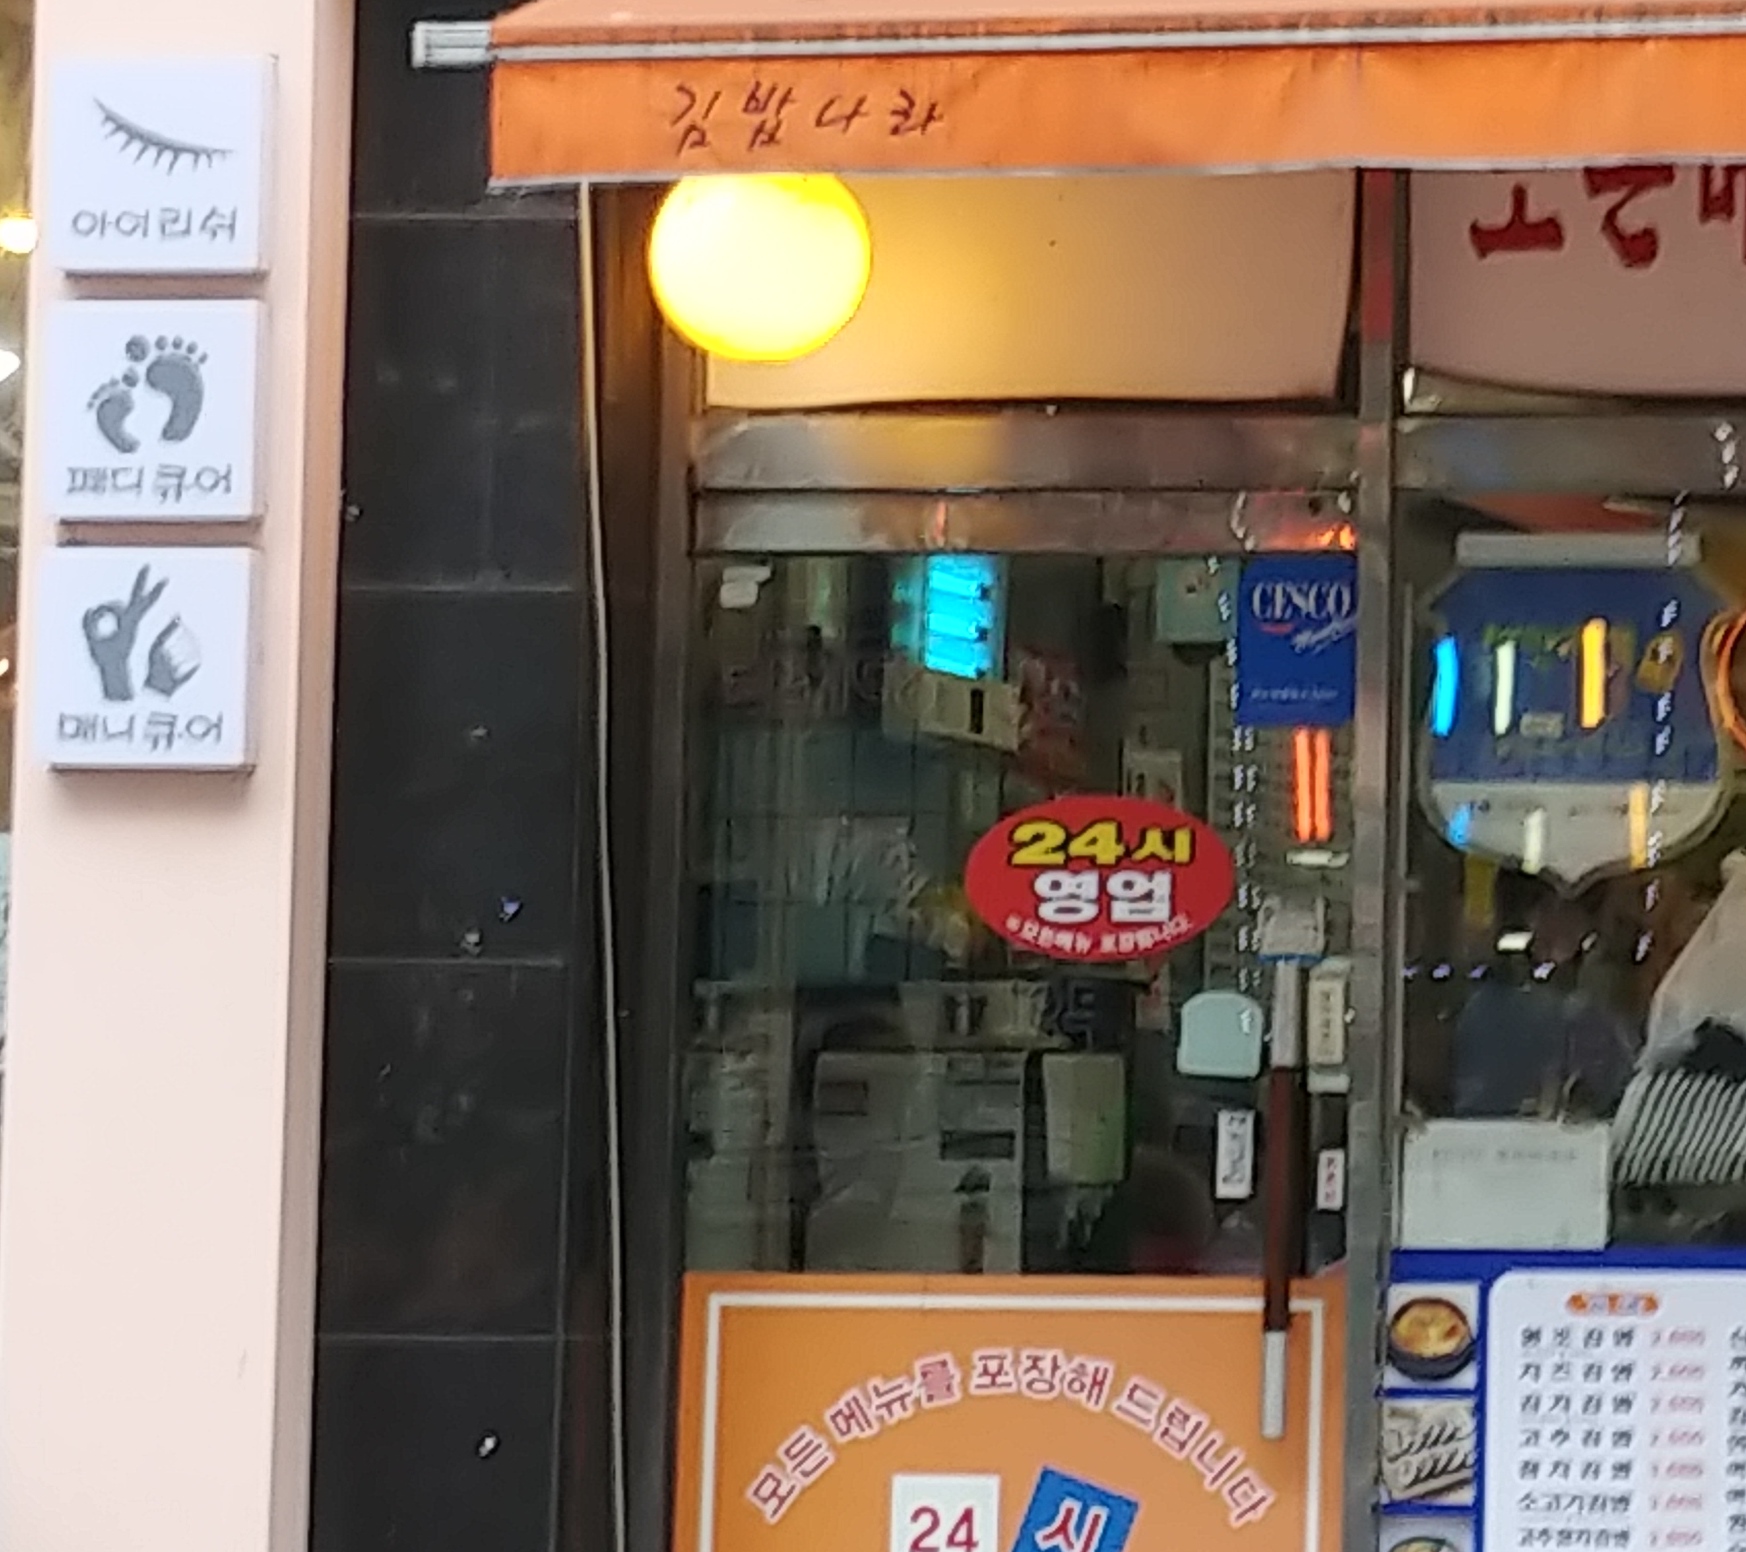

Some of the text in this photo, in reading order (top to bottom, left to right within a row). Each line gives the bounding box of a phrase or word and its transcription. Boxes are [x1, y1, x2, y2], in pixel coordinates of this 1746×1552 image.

[670, 80, 944, 157] 김밥나라
[1009, 817, 1196, 868] 24시
[1033, 867, 1174, 925] 영업
[749, 1350, 1275, 1525] 모든 메뉴를 포장해 드립니다
